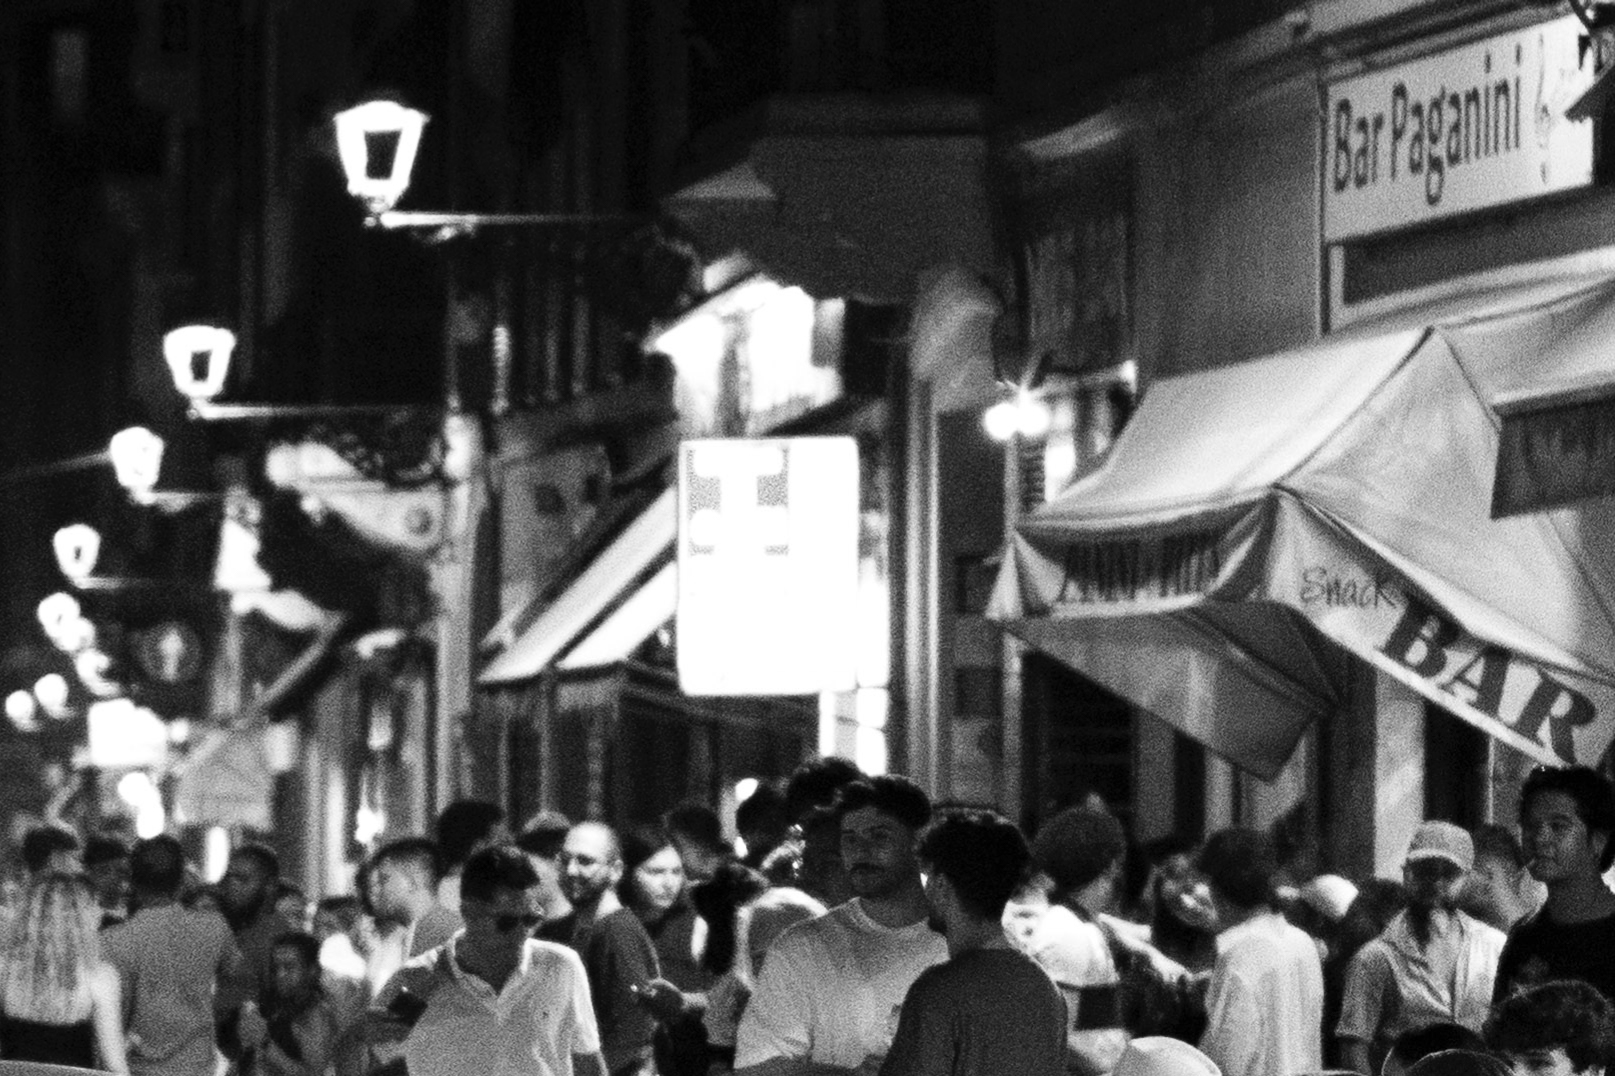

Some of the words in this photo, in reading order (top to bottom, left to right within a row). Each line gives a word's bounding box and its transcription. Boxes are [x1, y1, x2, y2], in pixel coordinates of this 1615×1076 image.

[1335, 98, 1384, 193] Bar
[1389, 43, 1522, 207] Paganini
[1299, 564, 1397, 609] Snack
[1383, 598, 1597, 766] BAR
